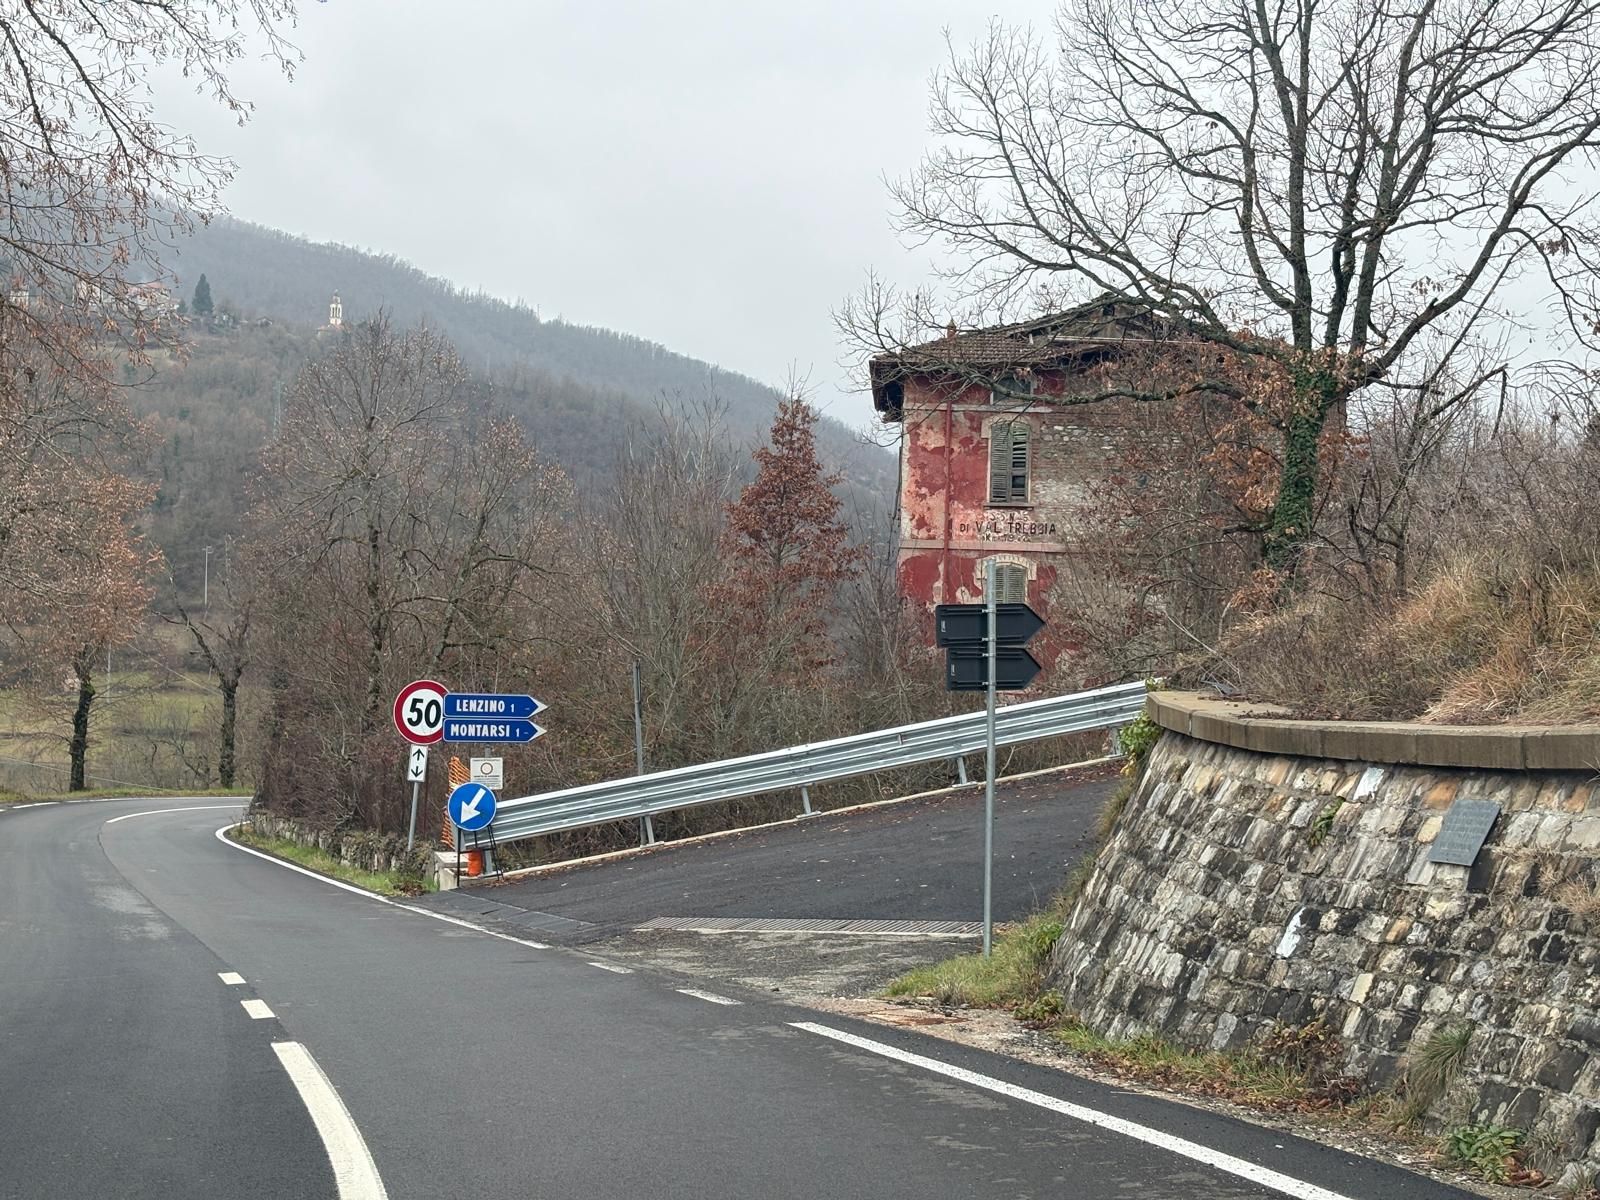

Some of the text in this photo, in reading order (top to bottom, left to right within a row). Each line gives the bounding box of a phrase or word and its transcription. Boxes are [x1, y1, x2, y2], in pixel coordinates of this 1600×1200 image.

[975, 521, 1001, 534] VAL
[407, 697, 442, 729] 50
[456, 699, 515, 713] LENZINO 1
[450, 723, 520, 737] MONTARSI 1
